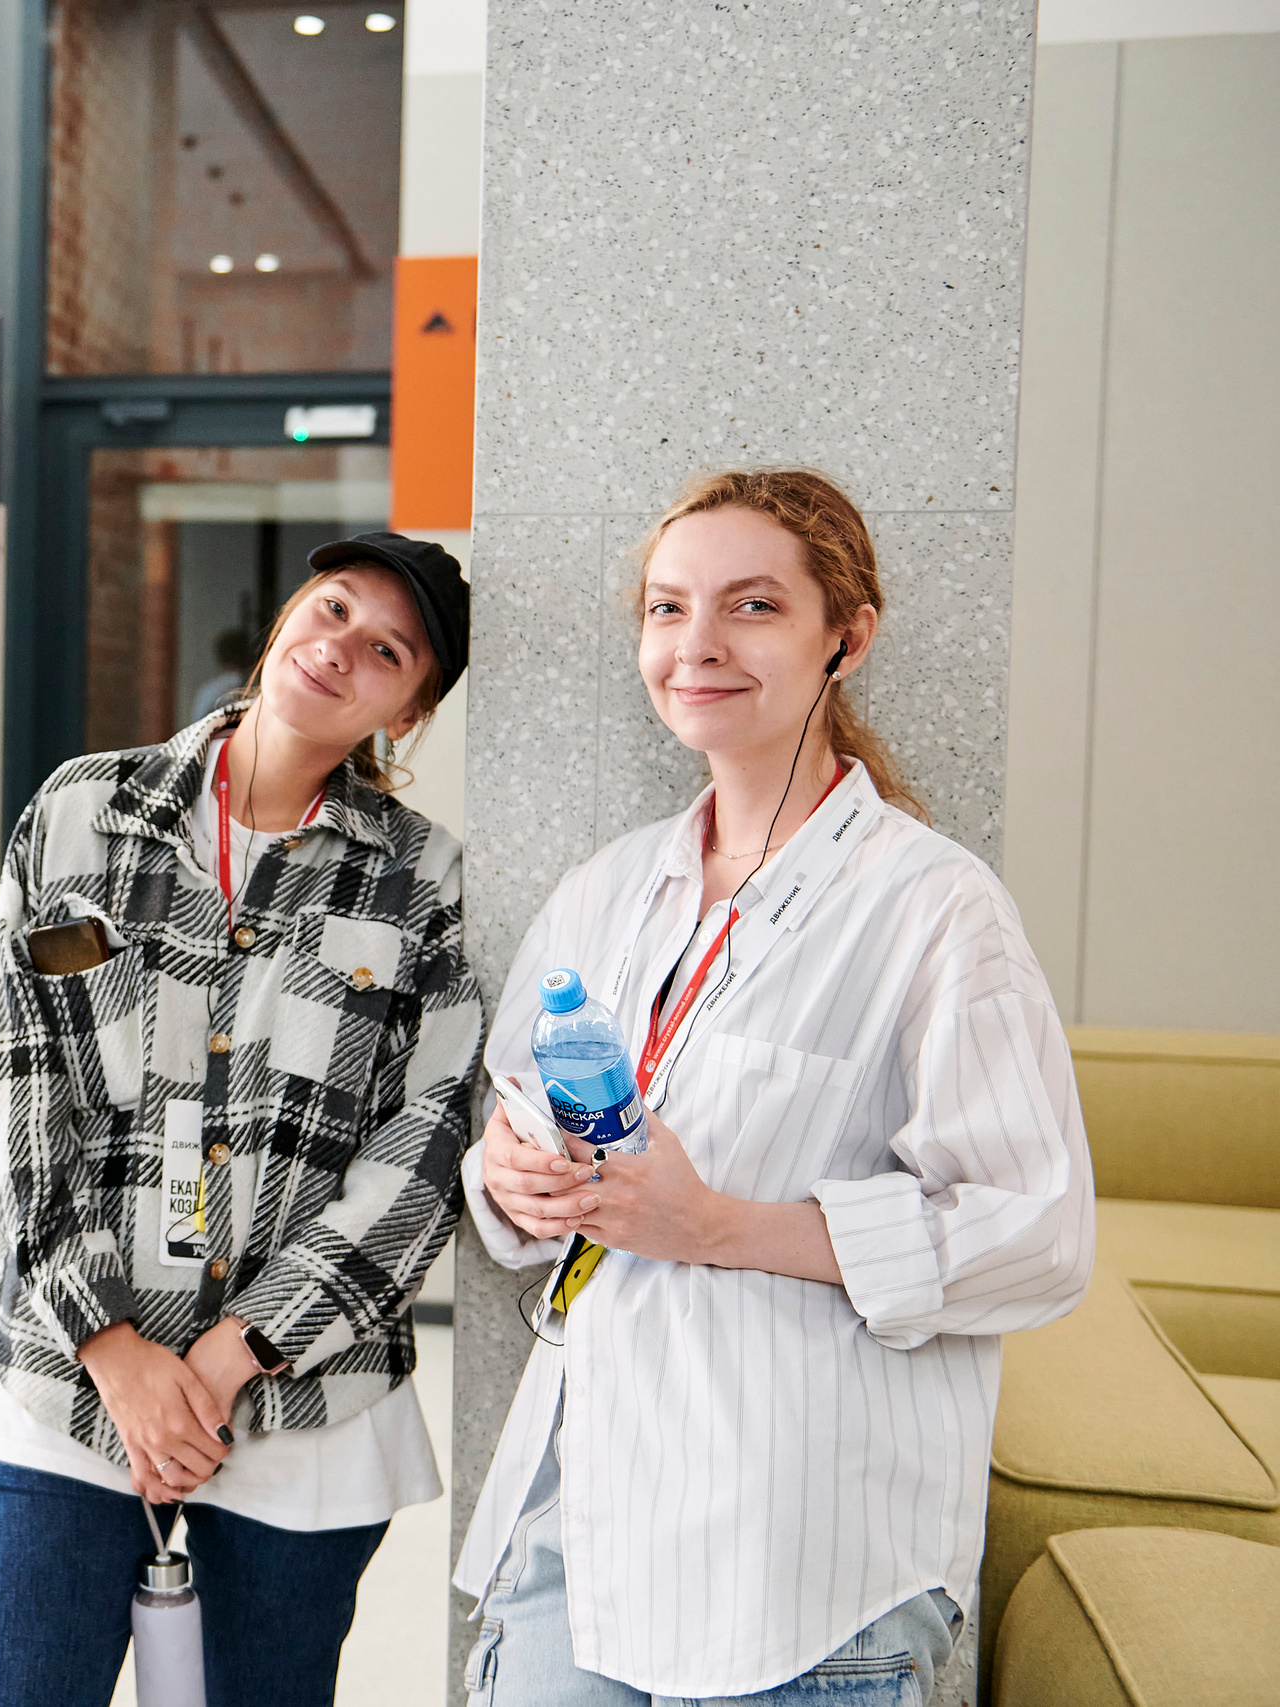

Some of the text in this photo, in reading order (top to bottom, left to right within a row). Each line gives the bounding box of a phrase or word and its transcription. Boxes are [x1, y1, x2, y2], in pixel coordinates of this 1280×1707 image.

[832, 808, 860, 842] ДВИЖЕНИЕ
[769, 884, 801, 925] ДВИЖЕНИЕ
[706, 971, 737, 1011] ДВИЖЕНИЕ
[653, 986, 694, 1060] www.crystal-sound.com
[646, 1058, 673, 1097] ДВИЖЕНИЕ
[548, 1096, 587, 1113] ОВО
